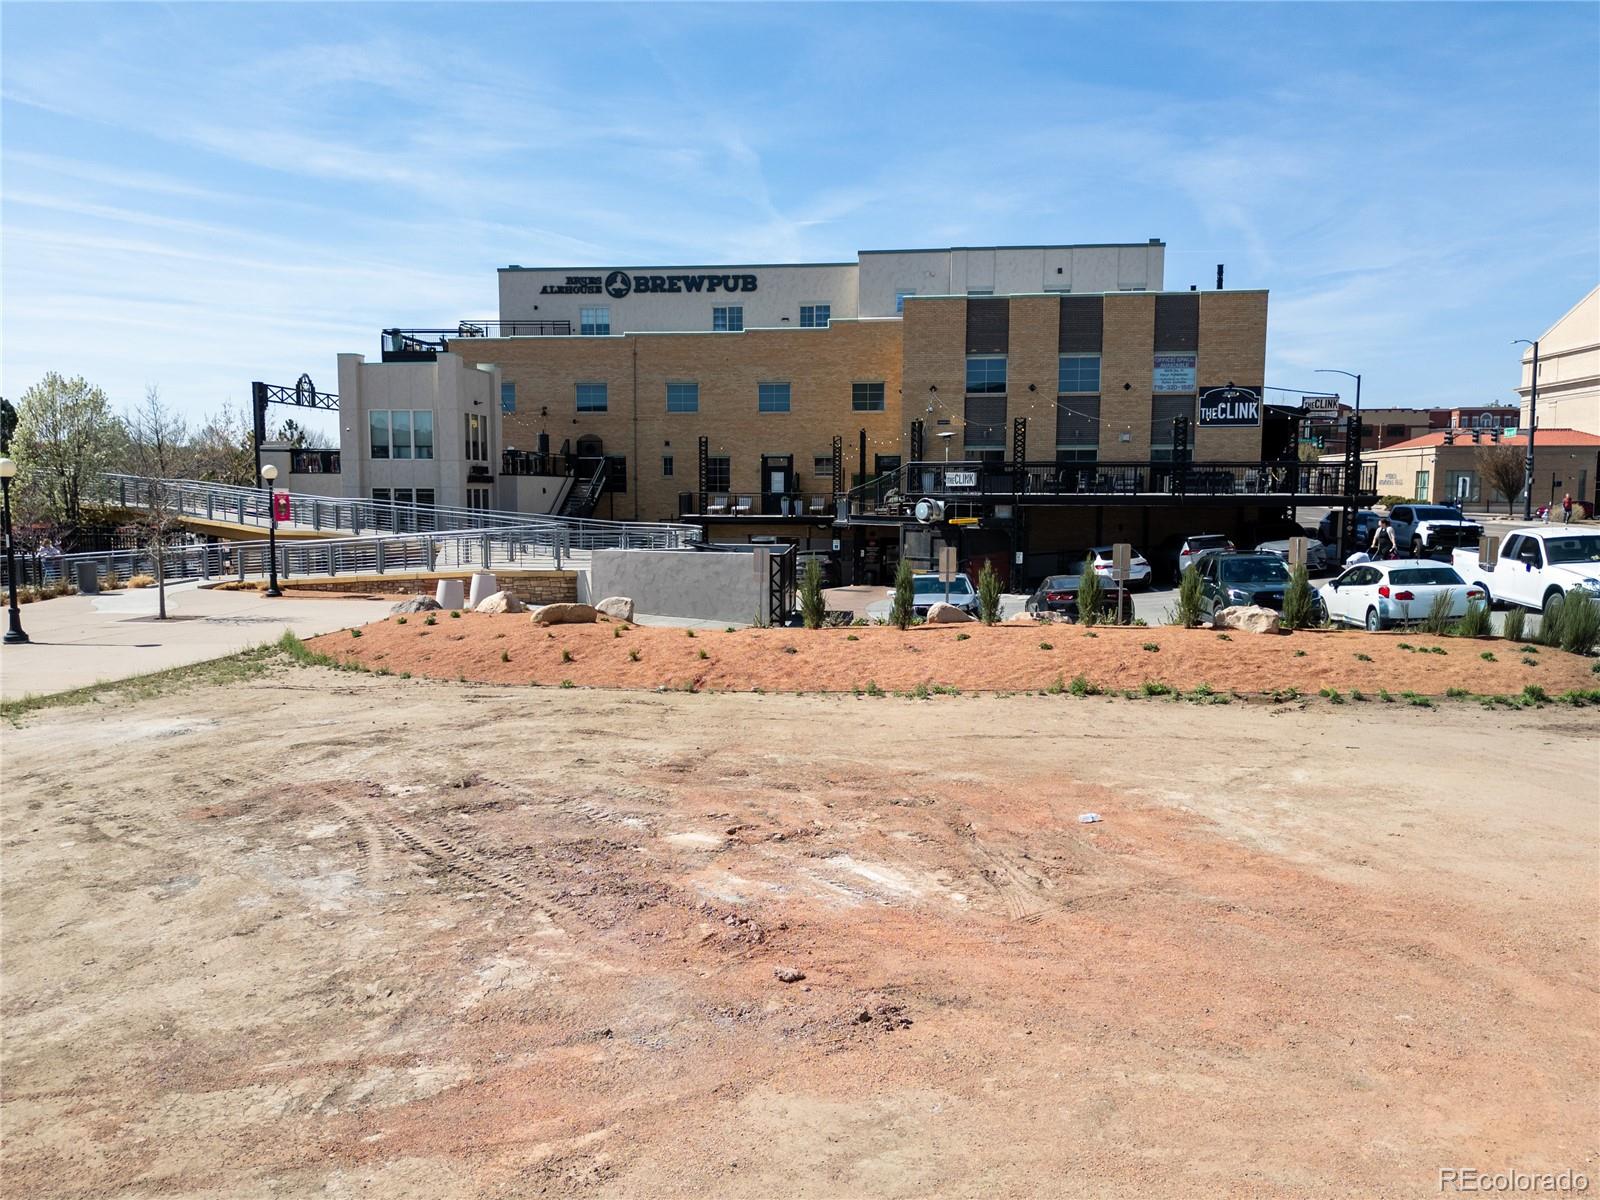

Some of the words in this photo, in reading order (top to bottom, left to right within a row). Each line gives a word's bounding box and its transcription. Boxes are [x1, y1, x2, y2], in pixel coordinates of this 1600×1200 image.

[633, 275, 758, 293] BREWPUB
[1201, 408, 1218, 419] THE
[1218, 402, 1258, 419] CLINK
[1315, 399, 1338, 409] CLINK
[954, 474, 974, 484] CLINK
